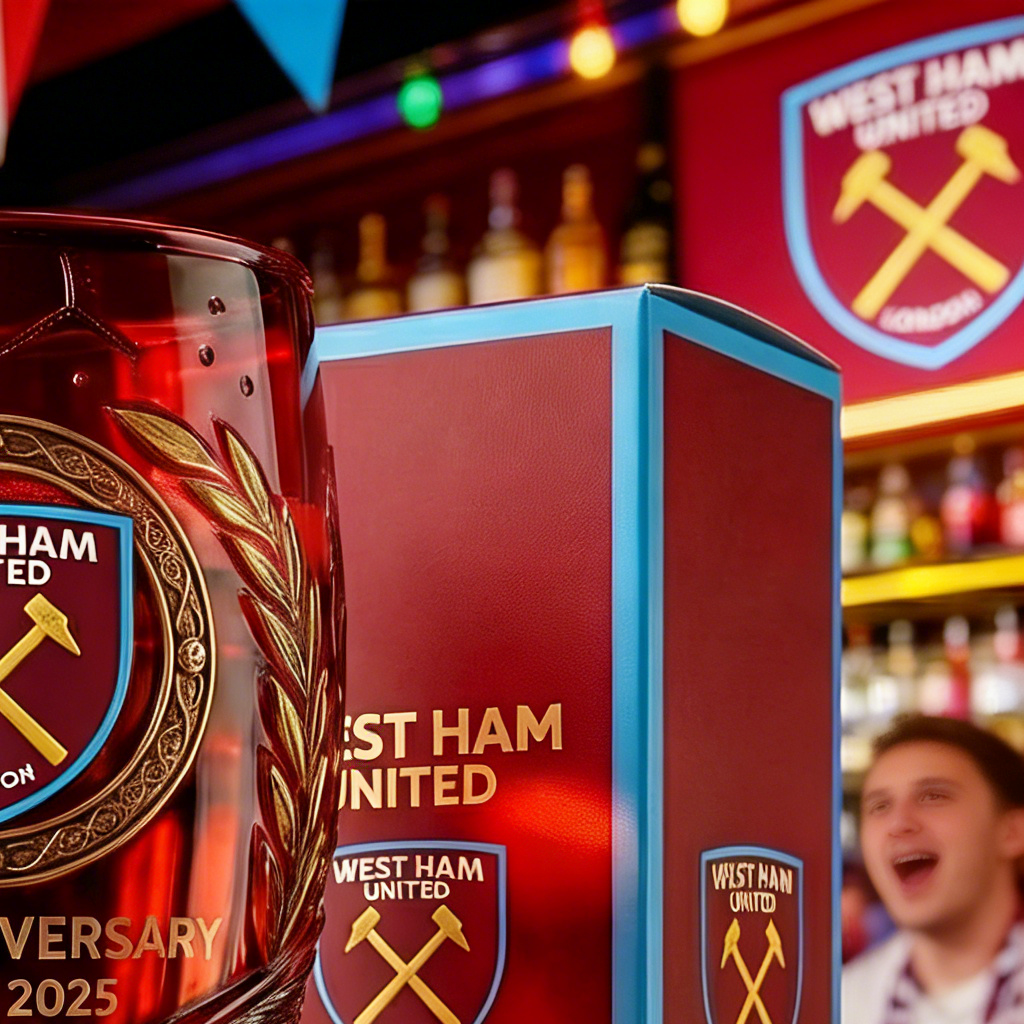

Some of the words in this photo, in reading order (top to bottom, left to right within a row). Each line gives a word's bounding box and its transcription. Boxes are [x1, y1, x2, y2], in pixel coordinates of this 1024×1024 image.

[807, 63, 921, 137] WEST
[854, 88, 989, 150] UNITED
[432, 703, 563, 756] HAM
[333, 855, 408, 884] WEST
[415, 855, 484, 882] HAM
[363, 881, 451, 901] UNITED
[6, 978, 119, 1018] 2025
